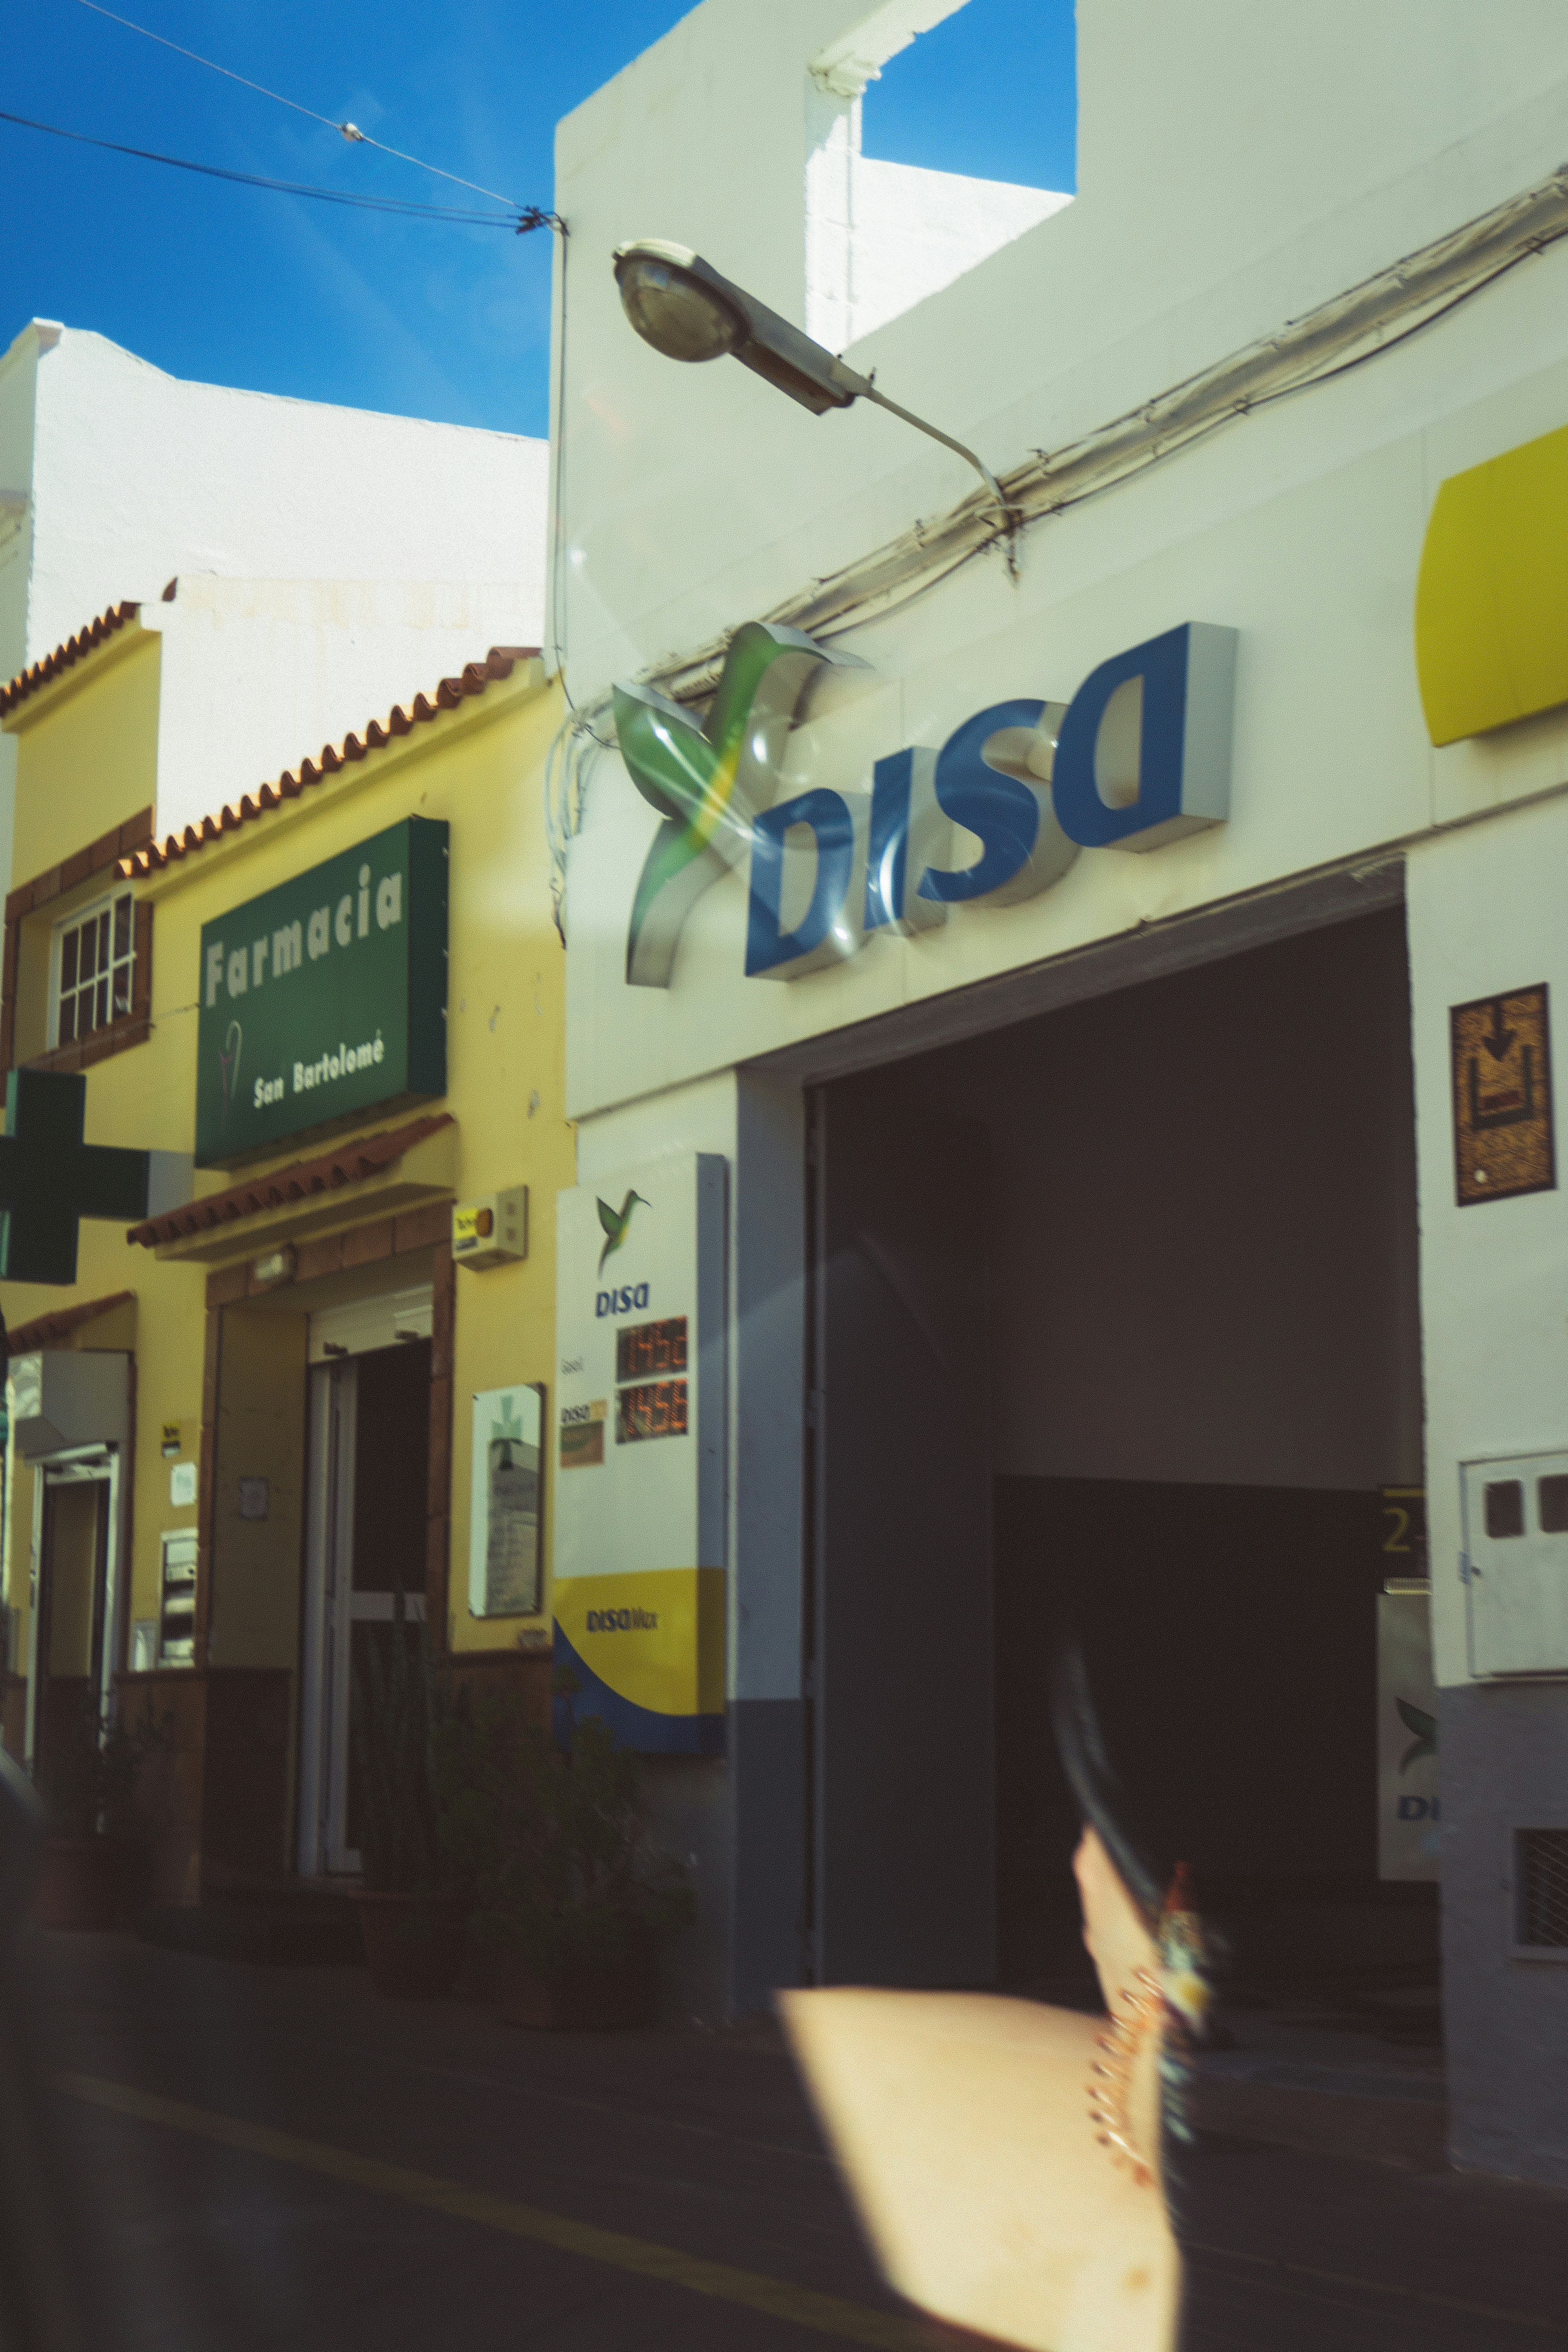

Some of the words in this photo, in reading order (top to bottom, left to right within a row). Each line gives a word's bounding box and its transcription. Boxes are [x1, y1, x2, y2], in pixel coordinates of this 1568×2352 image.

[205, 863, 403, 1008] Farmacia
[254, 1076, 285, 1109] San
[293, 1029, 385, 1094] Bartolomé
[1383, 1507, 1410, 1552] 2
